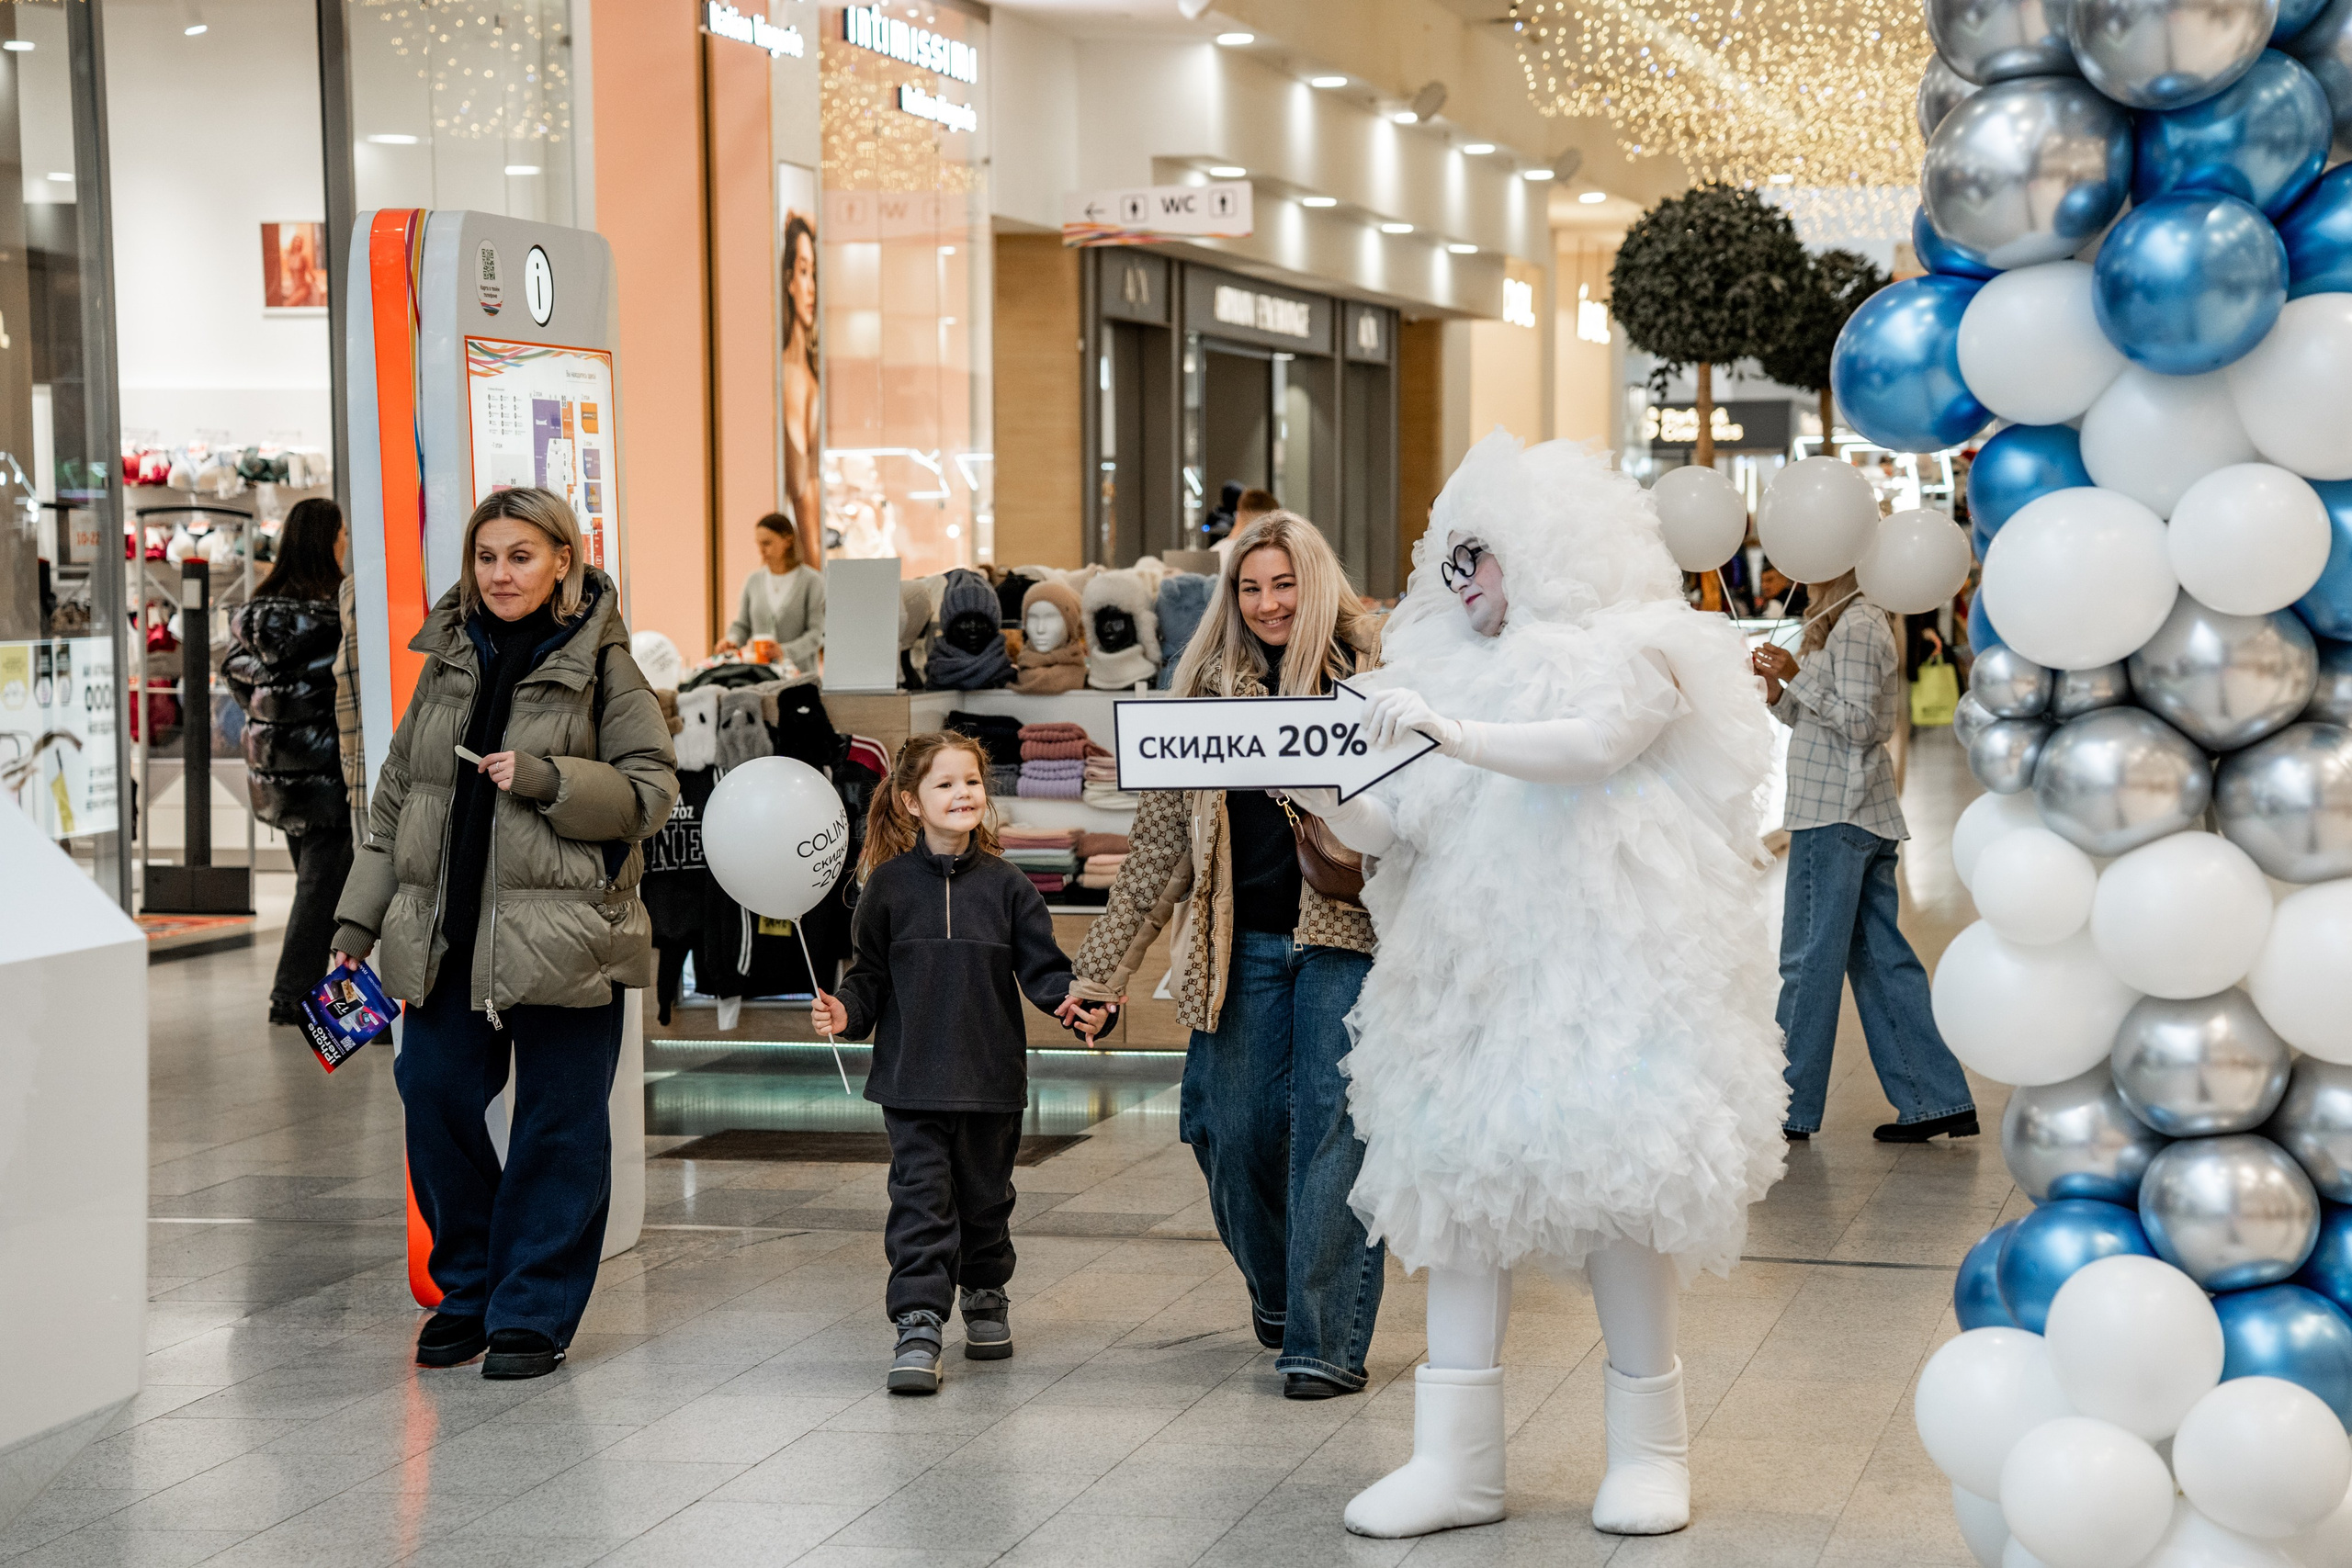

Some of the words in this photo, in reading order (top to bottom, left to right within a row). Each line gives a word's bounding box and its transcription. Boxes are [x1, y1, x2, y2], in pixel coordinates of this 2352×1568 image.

[1161, 195, 1198, 214] WC
[1138, 735, 1266, 763] СКИДКА
[1278, 723, 1368, 757] 20%
[335, 1001, 349, 1014] 17
[308, 1022, 336, 1066] iPhone
[316, 1026, 342, 1060] легко
